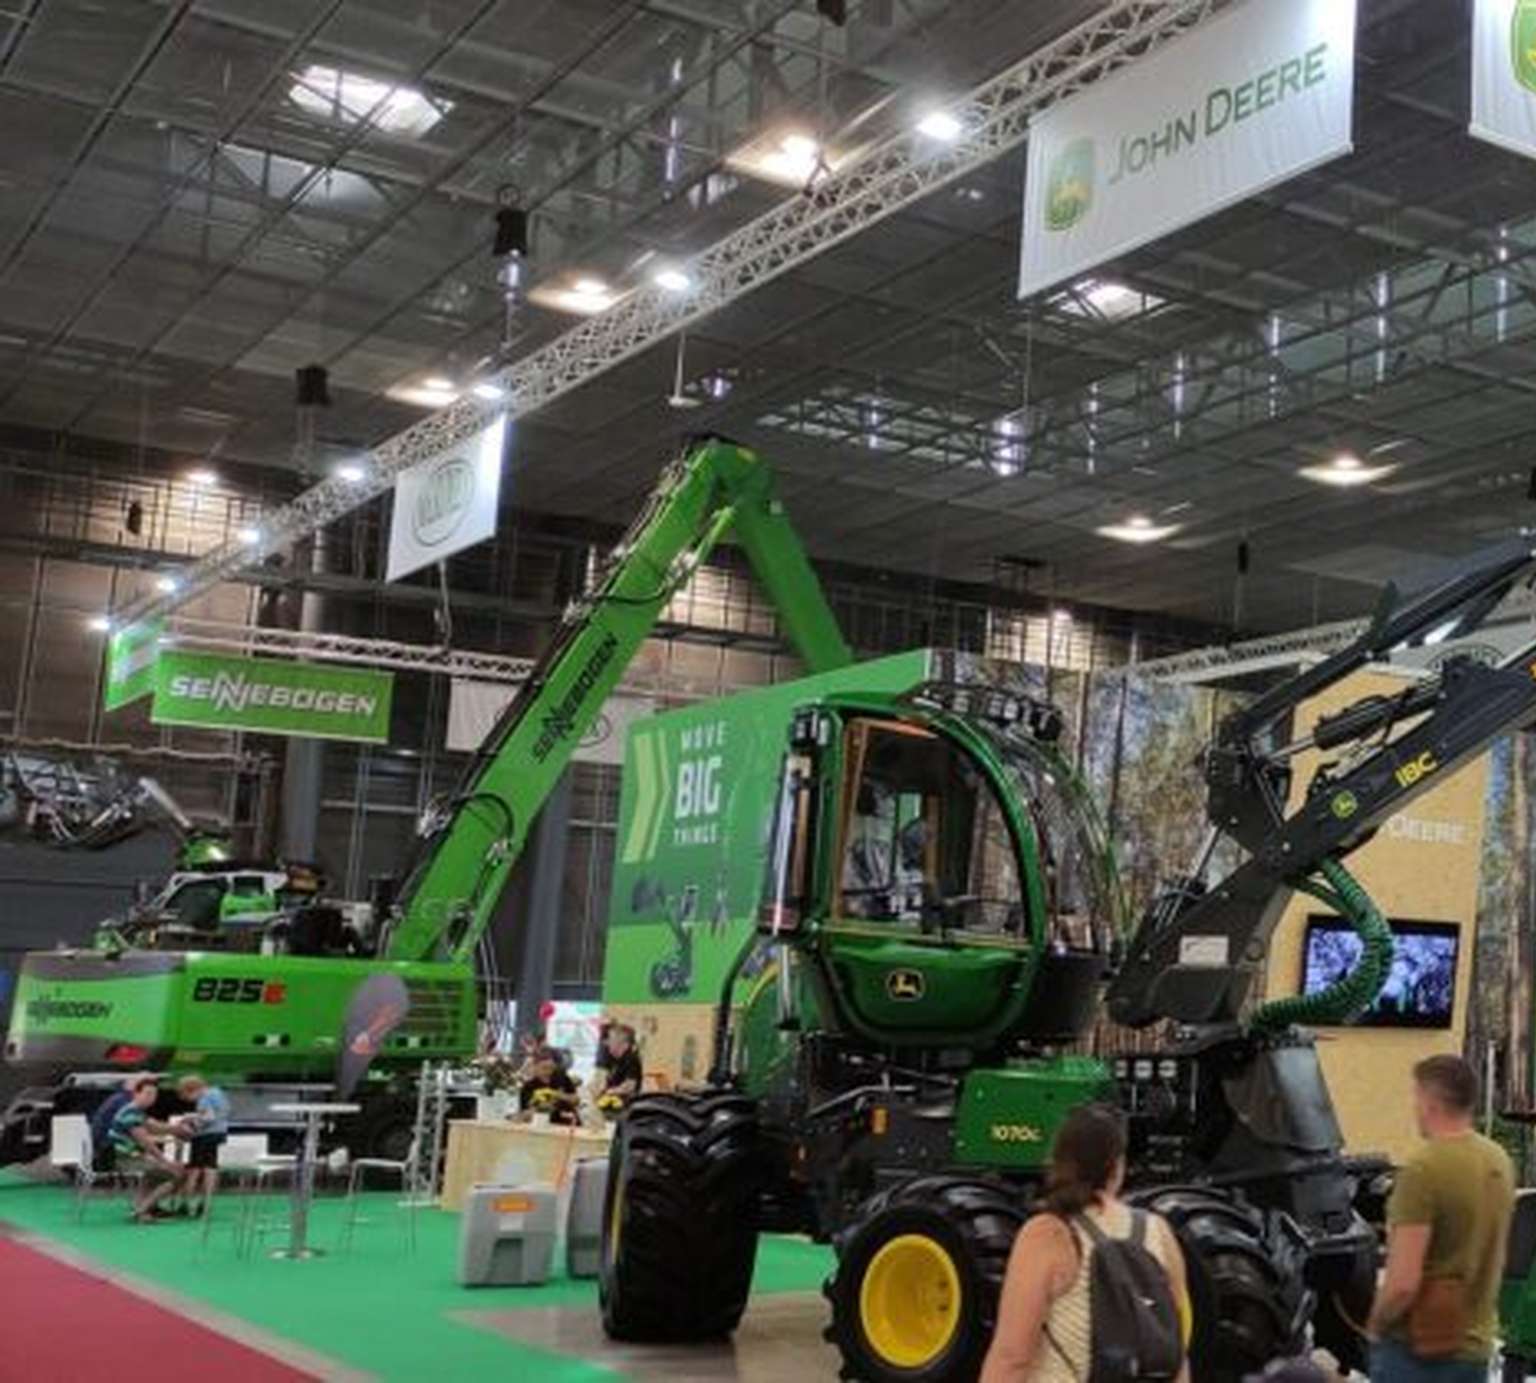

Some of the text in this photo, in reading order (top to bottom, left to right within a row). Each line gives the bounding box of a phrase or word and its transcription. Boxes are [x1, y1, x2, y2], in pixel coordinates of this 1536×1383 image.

[1109, 43, 1328, 184] JOHN DEERE
[170, 671, 377, 717] SENNEBOGEN
[676, 757, 722, 819] BIG
